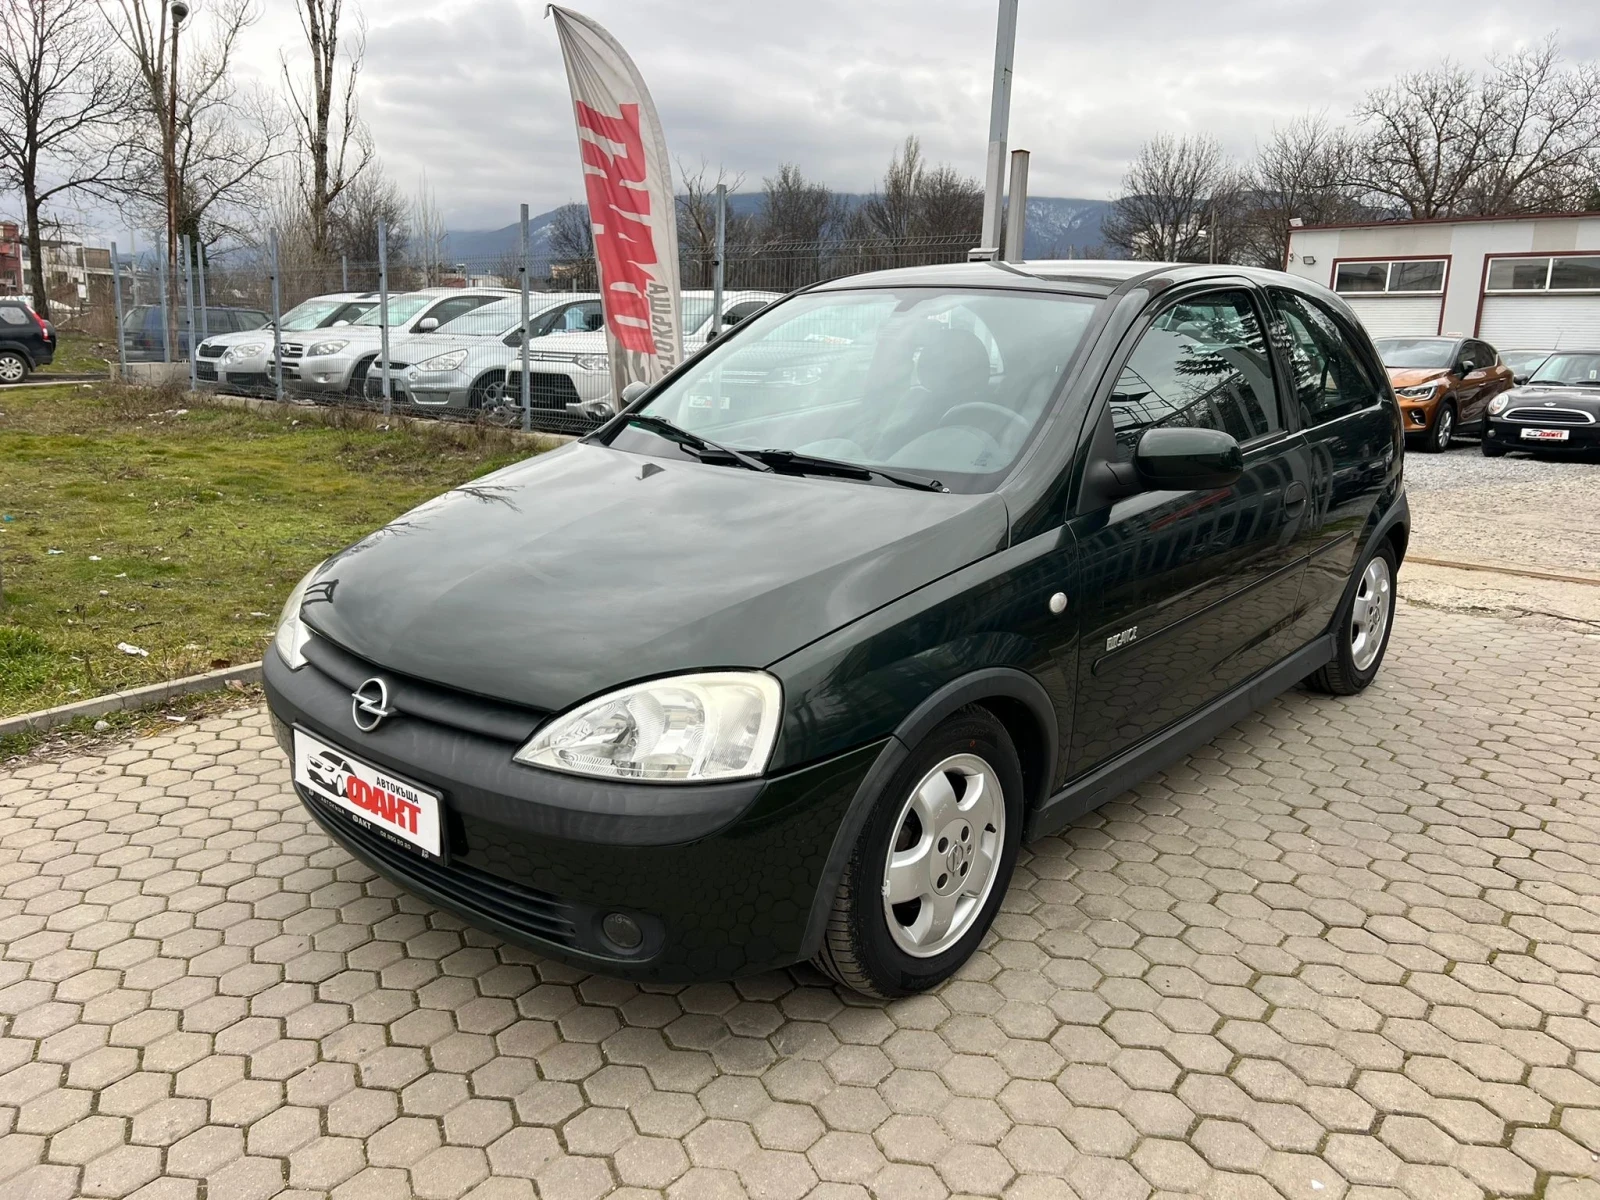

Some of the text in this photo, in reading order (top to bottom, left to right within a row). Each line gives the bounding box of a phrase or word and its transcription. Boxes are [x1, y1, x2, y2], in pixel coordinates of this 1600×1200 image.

[376, 776, 419, 804] АВТОКЪЩА
[347, 775, 421, 835] ФАКТ
[352, 814, 372, 830] ФАКТ
